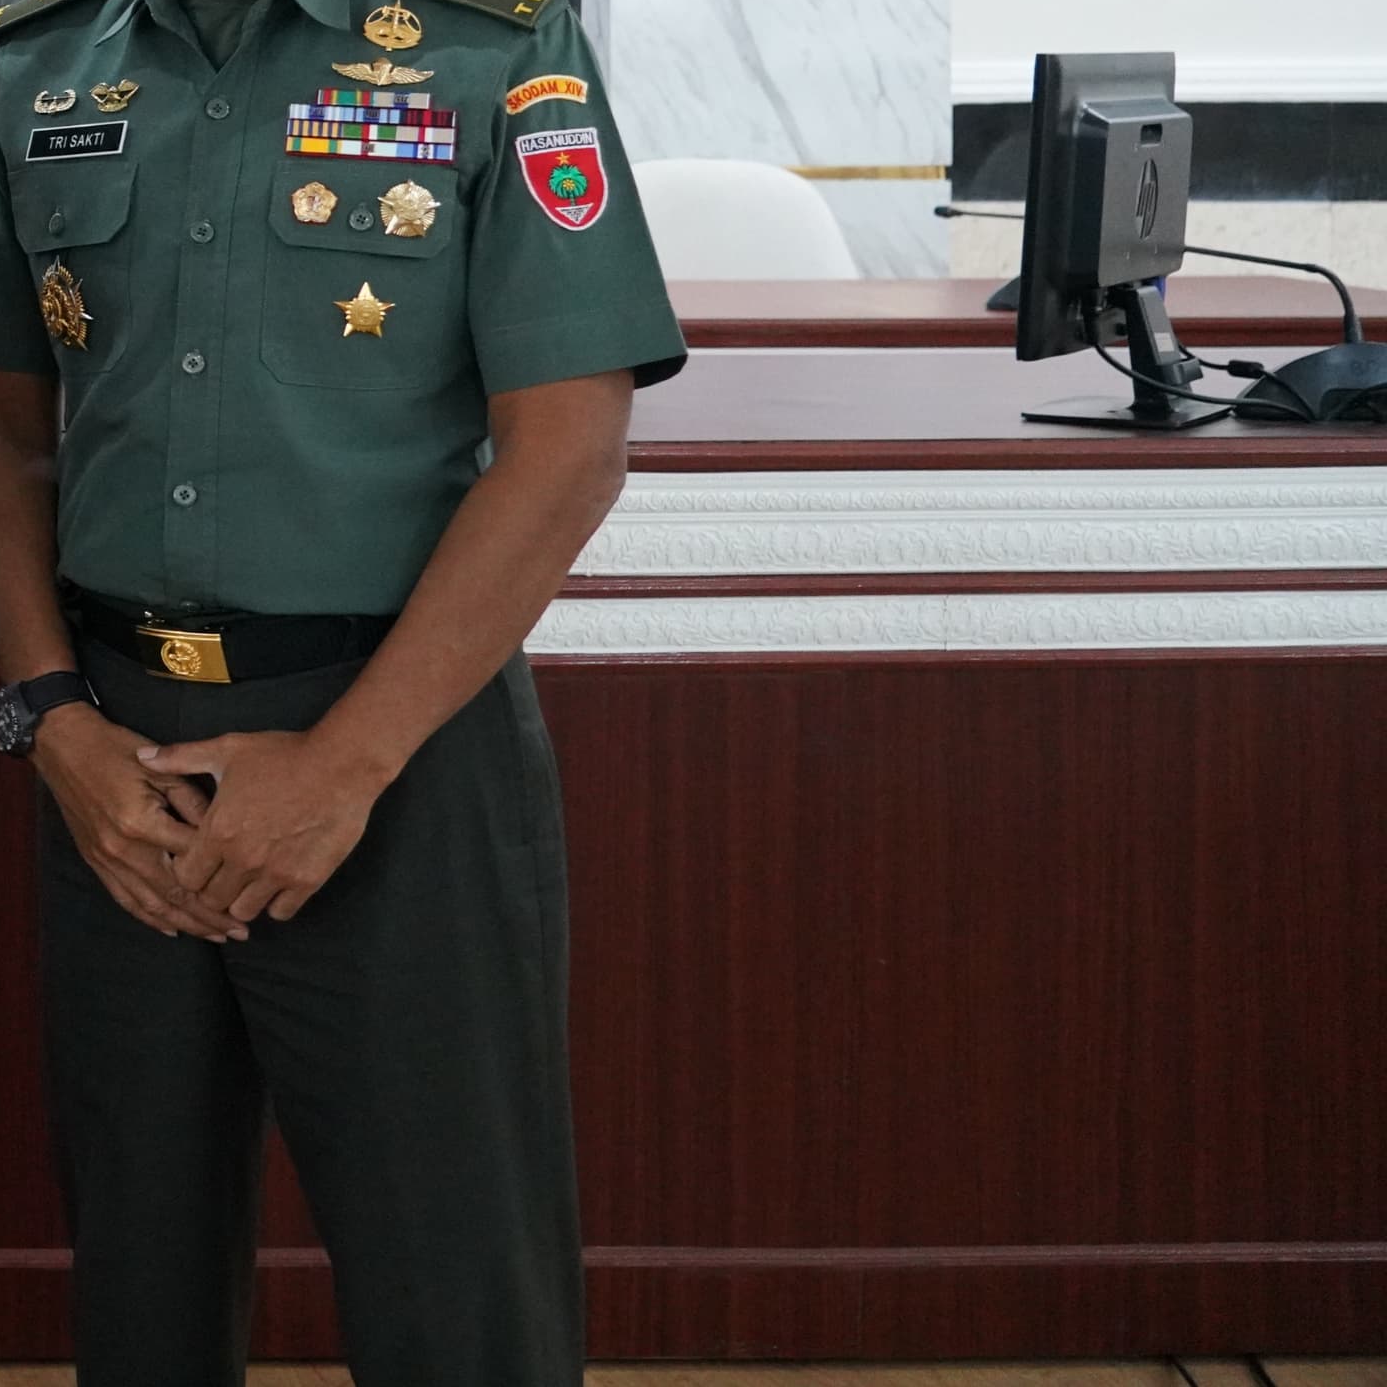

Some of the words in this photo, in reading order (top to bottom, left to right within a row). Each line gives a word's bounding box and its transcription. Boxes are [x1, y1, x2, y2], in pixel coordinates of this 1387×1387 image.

[48, 136, 68, 150] TRI
[69, 132, 105, 149] SAKTI
[520, 132, 593, 153] HASANUDDIN
